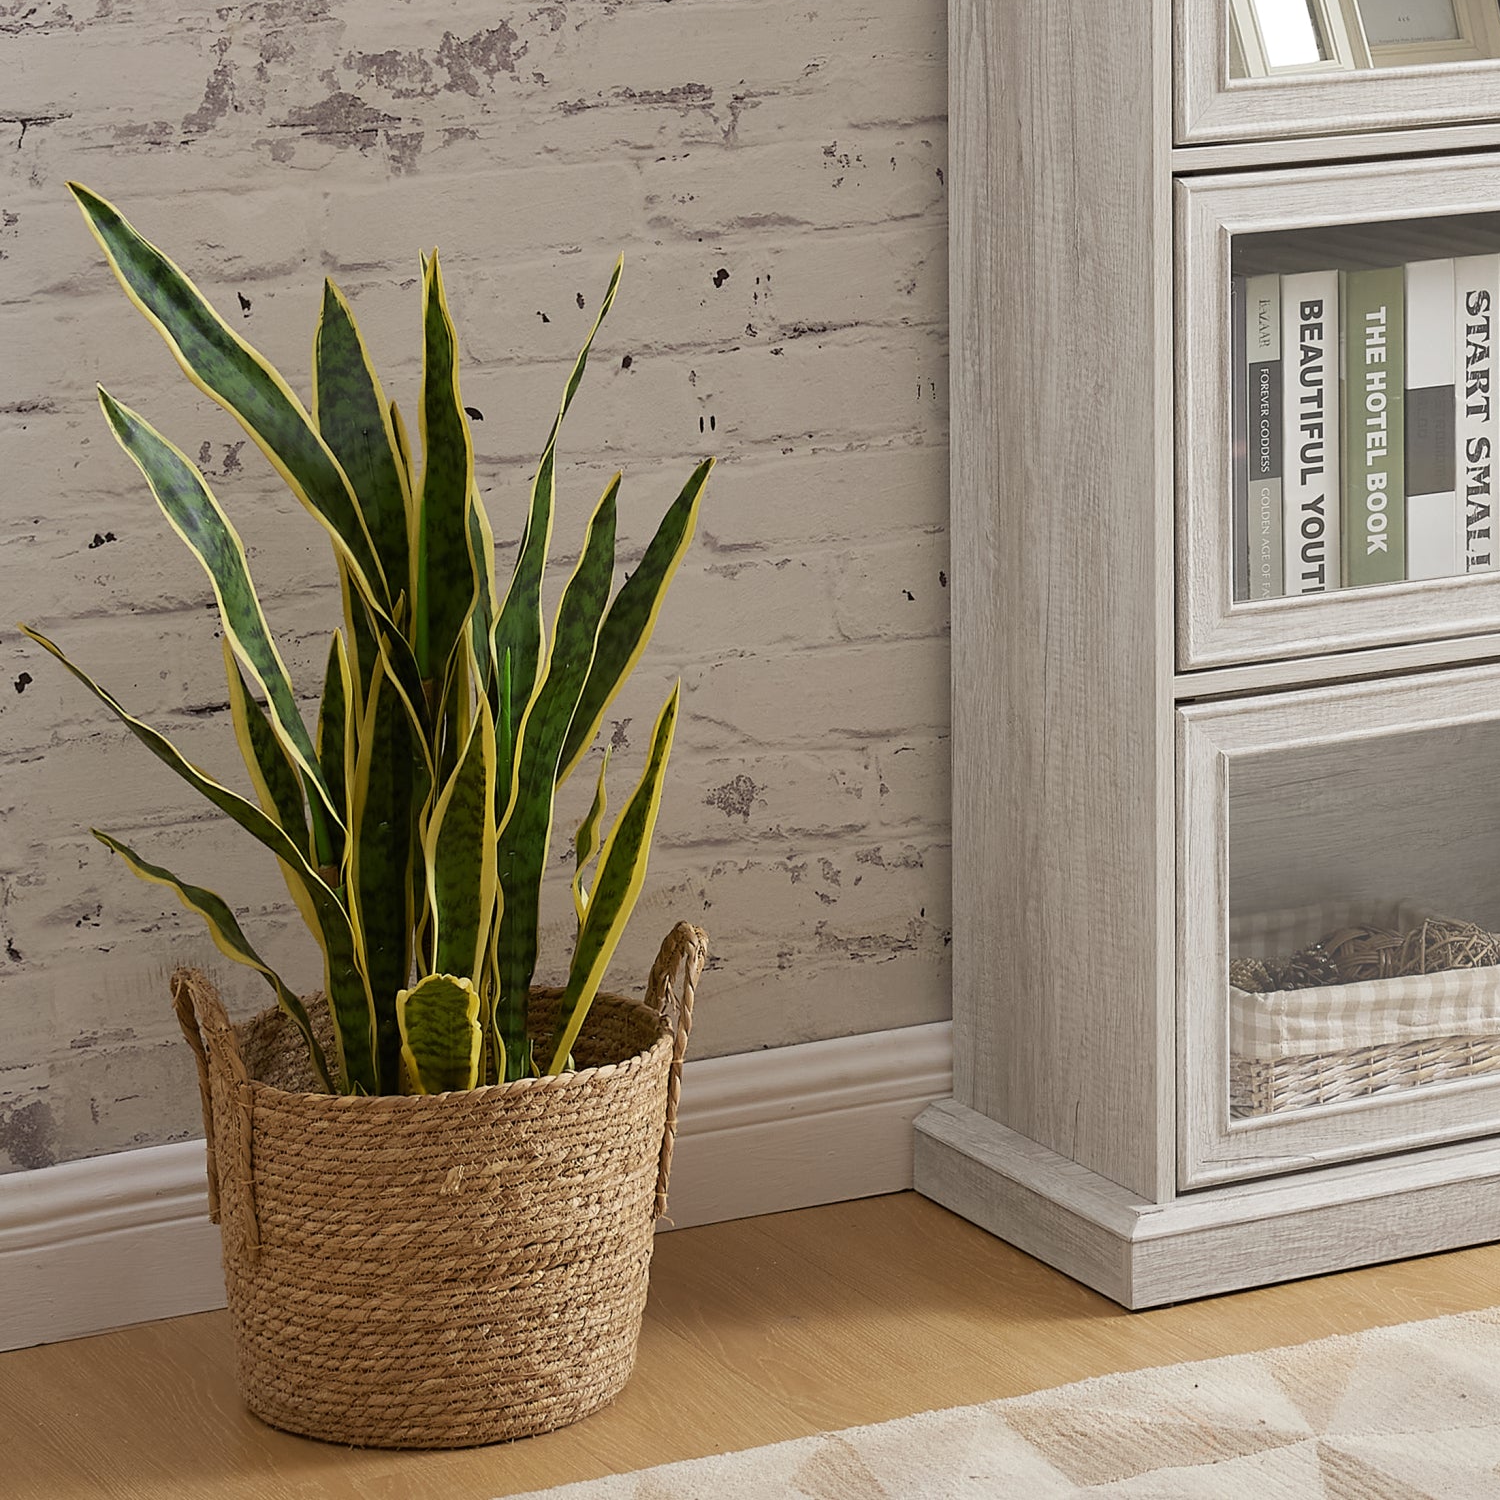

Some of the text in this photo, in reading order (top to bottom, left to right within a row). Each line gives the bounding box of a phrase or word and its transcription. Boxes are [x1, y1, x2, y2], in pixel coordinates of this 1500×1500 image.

[1299, 299, 1324, 486] BEAUTIFUL
[1465, 290, 1491, 423] START
[1260, 368, 1270, 473] FOREVER GODDESS
[1365, 306, 1388, 556] THE HOTEL BOOK
[1261, 487, 1271, 535] GOLDEN
[1262, 538, 1271, 561] AGE
[1262, 563, 1271, 579] OF
